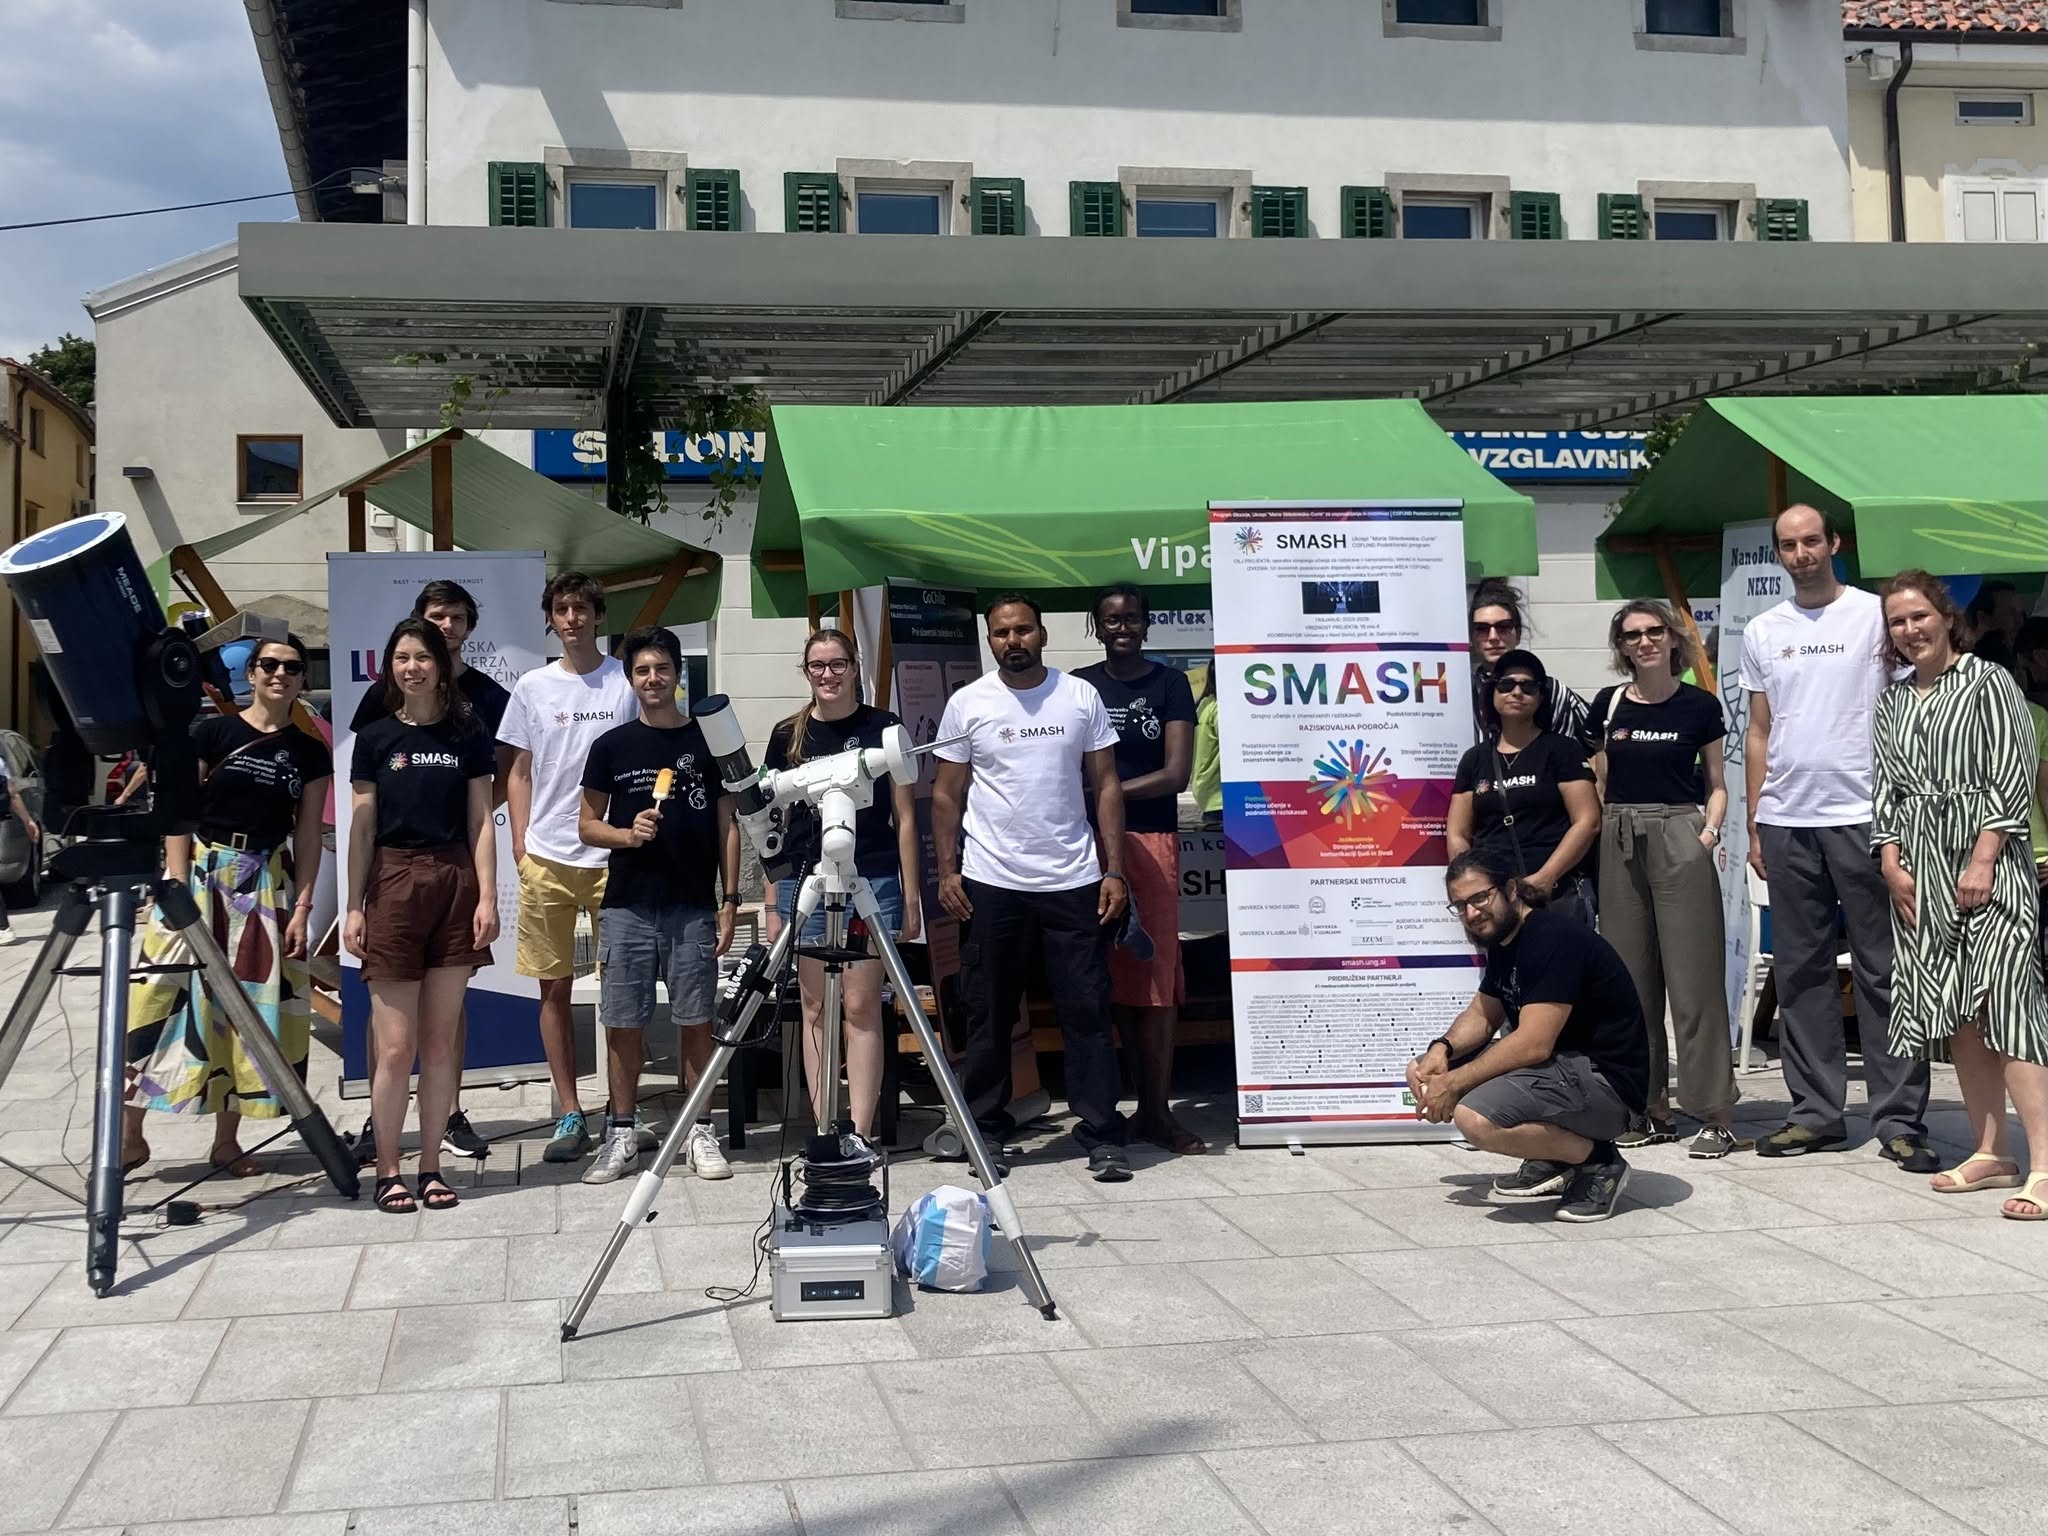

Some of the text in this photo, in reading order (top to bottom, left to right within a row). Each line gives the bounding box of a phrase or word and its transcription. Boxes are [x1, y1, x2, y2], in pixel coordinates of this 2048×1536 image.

[572, 430, 766, 463] SLON
[1276, 534, 1346, 549] SMASH
[1731, 546, 1780, 566] NanoBio
[116, 566, 142, 613] MEADE
[1747, 576, 1781, 596] NEXUS
[1800, 644, 1844, 655] SMASH
[1244, 662, 1448, 706] SMASH
[573, 711, 614, 722] SMASH
[1020, 726, 1065, 738] SMASH
[1357, 722, 1399, 730] PODROČJA
[1631, 730, 1678, 740] SMASH
[412, 752, 458, 768] SMASH
[1178, 870, 1226, 896] SH
